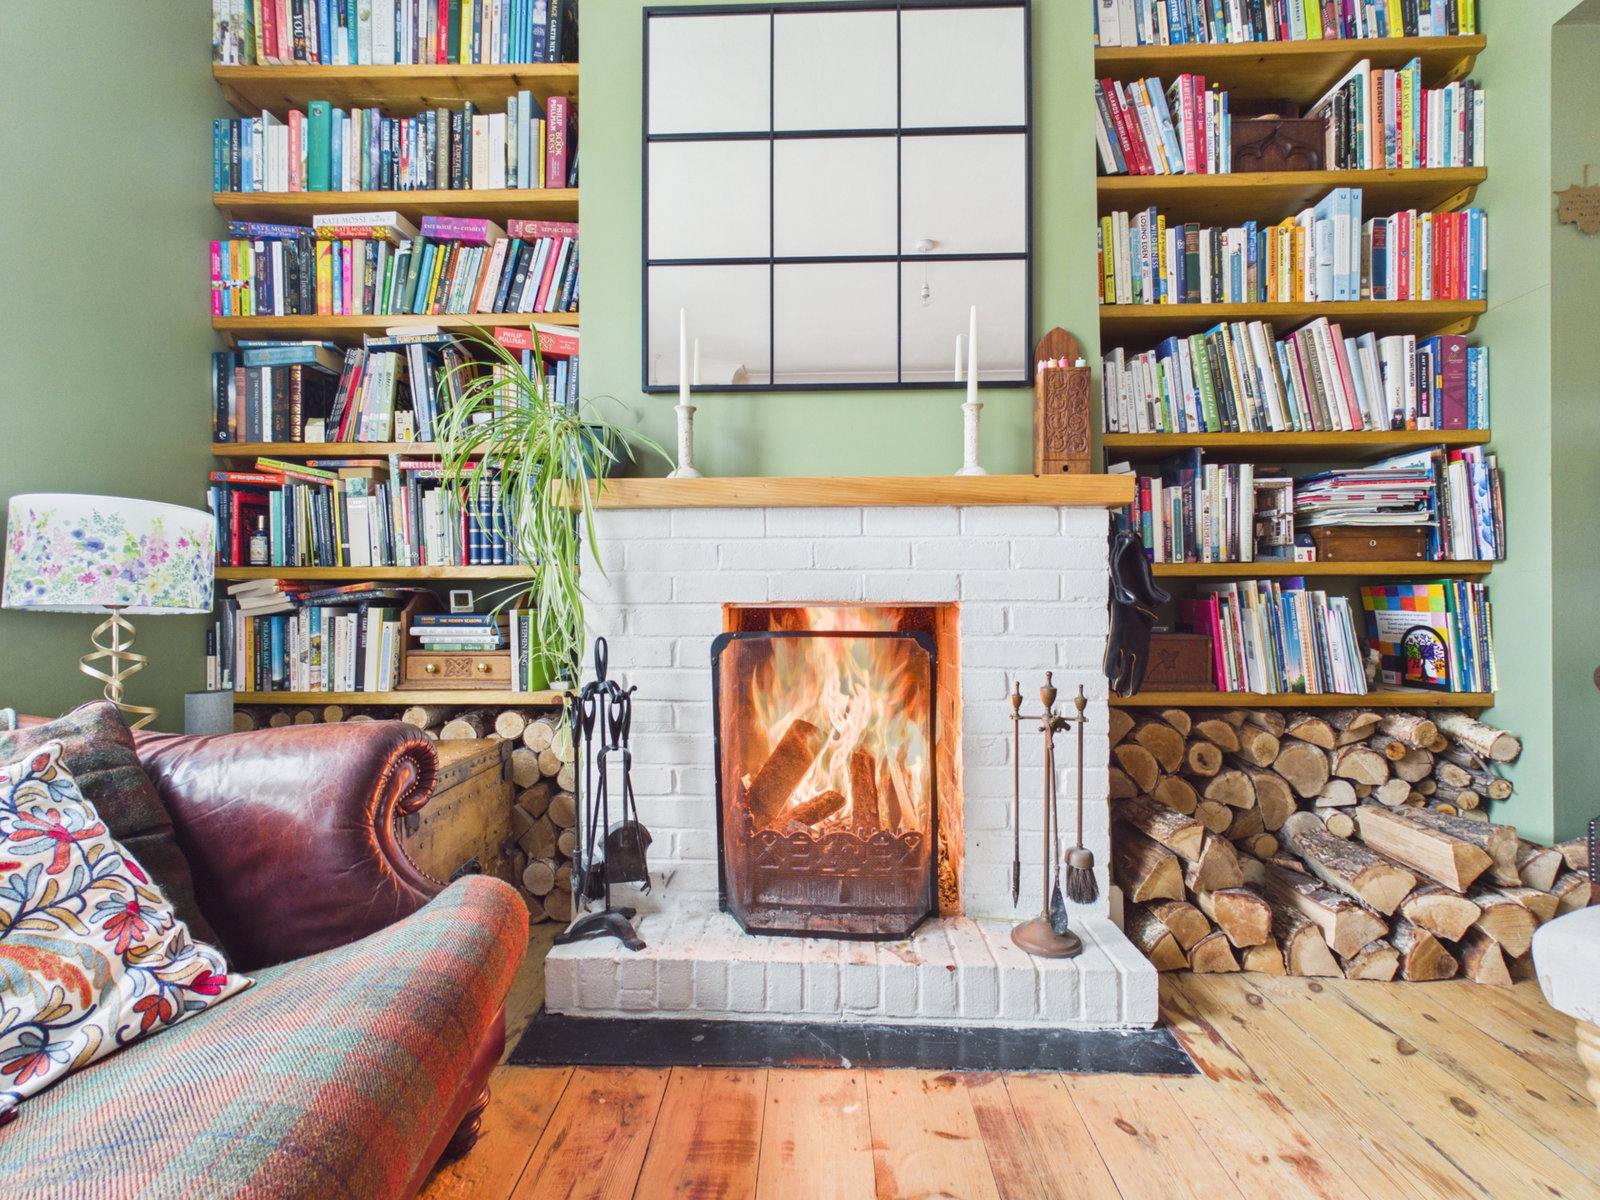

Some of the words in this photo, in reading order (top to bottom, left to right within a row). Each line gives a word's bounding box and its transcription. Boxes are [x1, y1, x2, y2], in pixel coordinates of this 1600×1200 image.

[1170, 0, 1179, 23] ITING
[293, 14, 304, 38] YOU
[549, 19, 557, 40] GARTH
[548, 40, 556, 53] NIX
[1182, 77, 1192, 107] JAMIE'S
[1376, 76, 1384, 125] BREADSONG
[1107, 90, 1119, 117] ISLANDS
[1117, 119, 1131, 153] HIGHLANDS
[1185, 120, 1194, 142] MINUTE
[548, 133, 556, 154] DUST
[554, 131, 563, 156] BOOK
[1186, 142, 1195, 161] MEALS
[454, 143, 463, 178] TORTALL
[251, 224, 270, 232] KATE
[271, 226, 295, 234] MOSSE
[321, 217, 341, 225] KATE
[342, 216, 368, 224] MOSSE
[1139, 215, 1148, 240] LOSING
[1150, 223, 1158, 269] WILDERNESS
[498, 335, 527, 345] PULLMAN
[502, 331, 523, 339] PHILIP
[1197, 339, 1206, 355] RAY
[1201, 356, 1211, 385] MEARS
[262, 621, 270, 651] MIRANDA
[520, 621, 529, 651] STEPHEN
[262, 651, 270, 669] HART
[520, 650, 529, 666] KING
